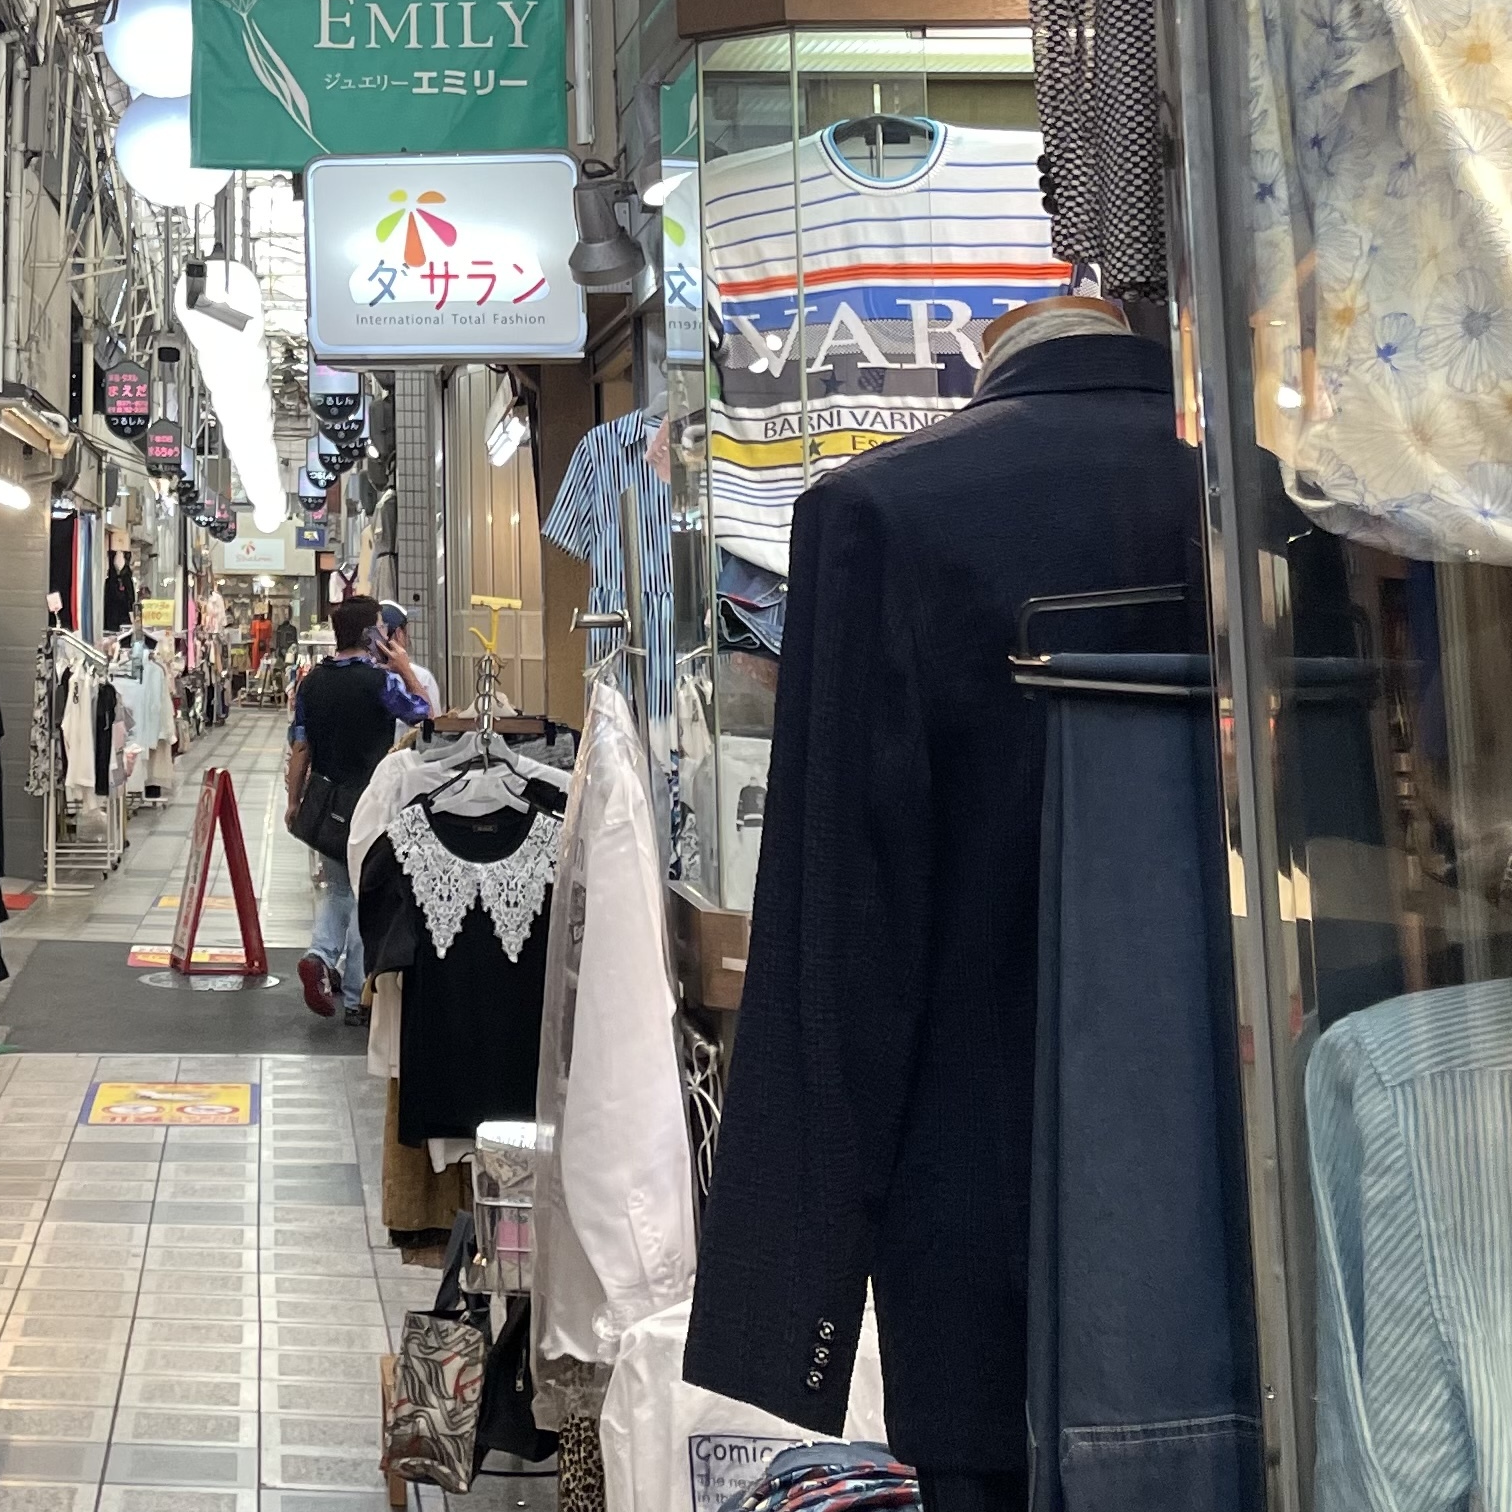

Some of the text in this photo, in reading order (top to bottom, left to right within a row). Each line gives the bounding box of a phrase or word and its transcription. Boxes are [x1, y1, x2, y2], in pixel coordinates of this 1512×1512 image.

[368, 259, 546, 310] ダサラン
[356, 313, 546, 325] International Total Fashion
[723, 297, 1029, 378] VAR
[763, 409, 842, 439] BARNI
